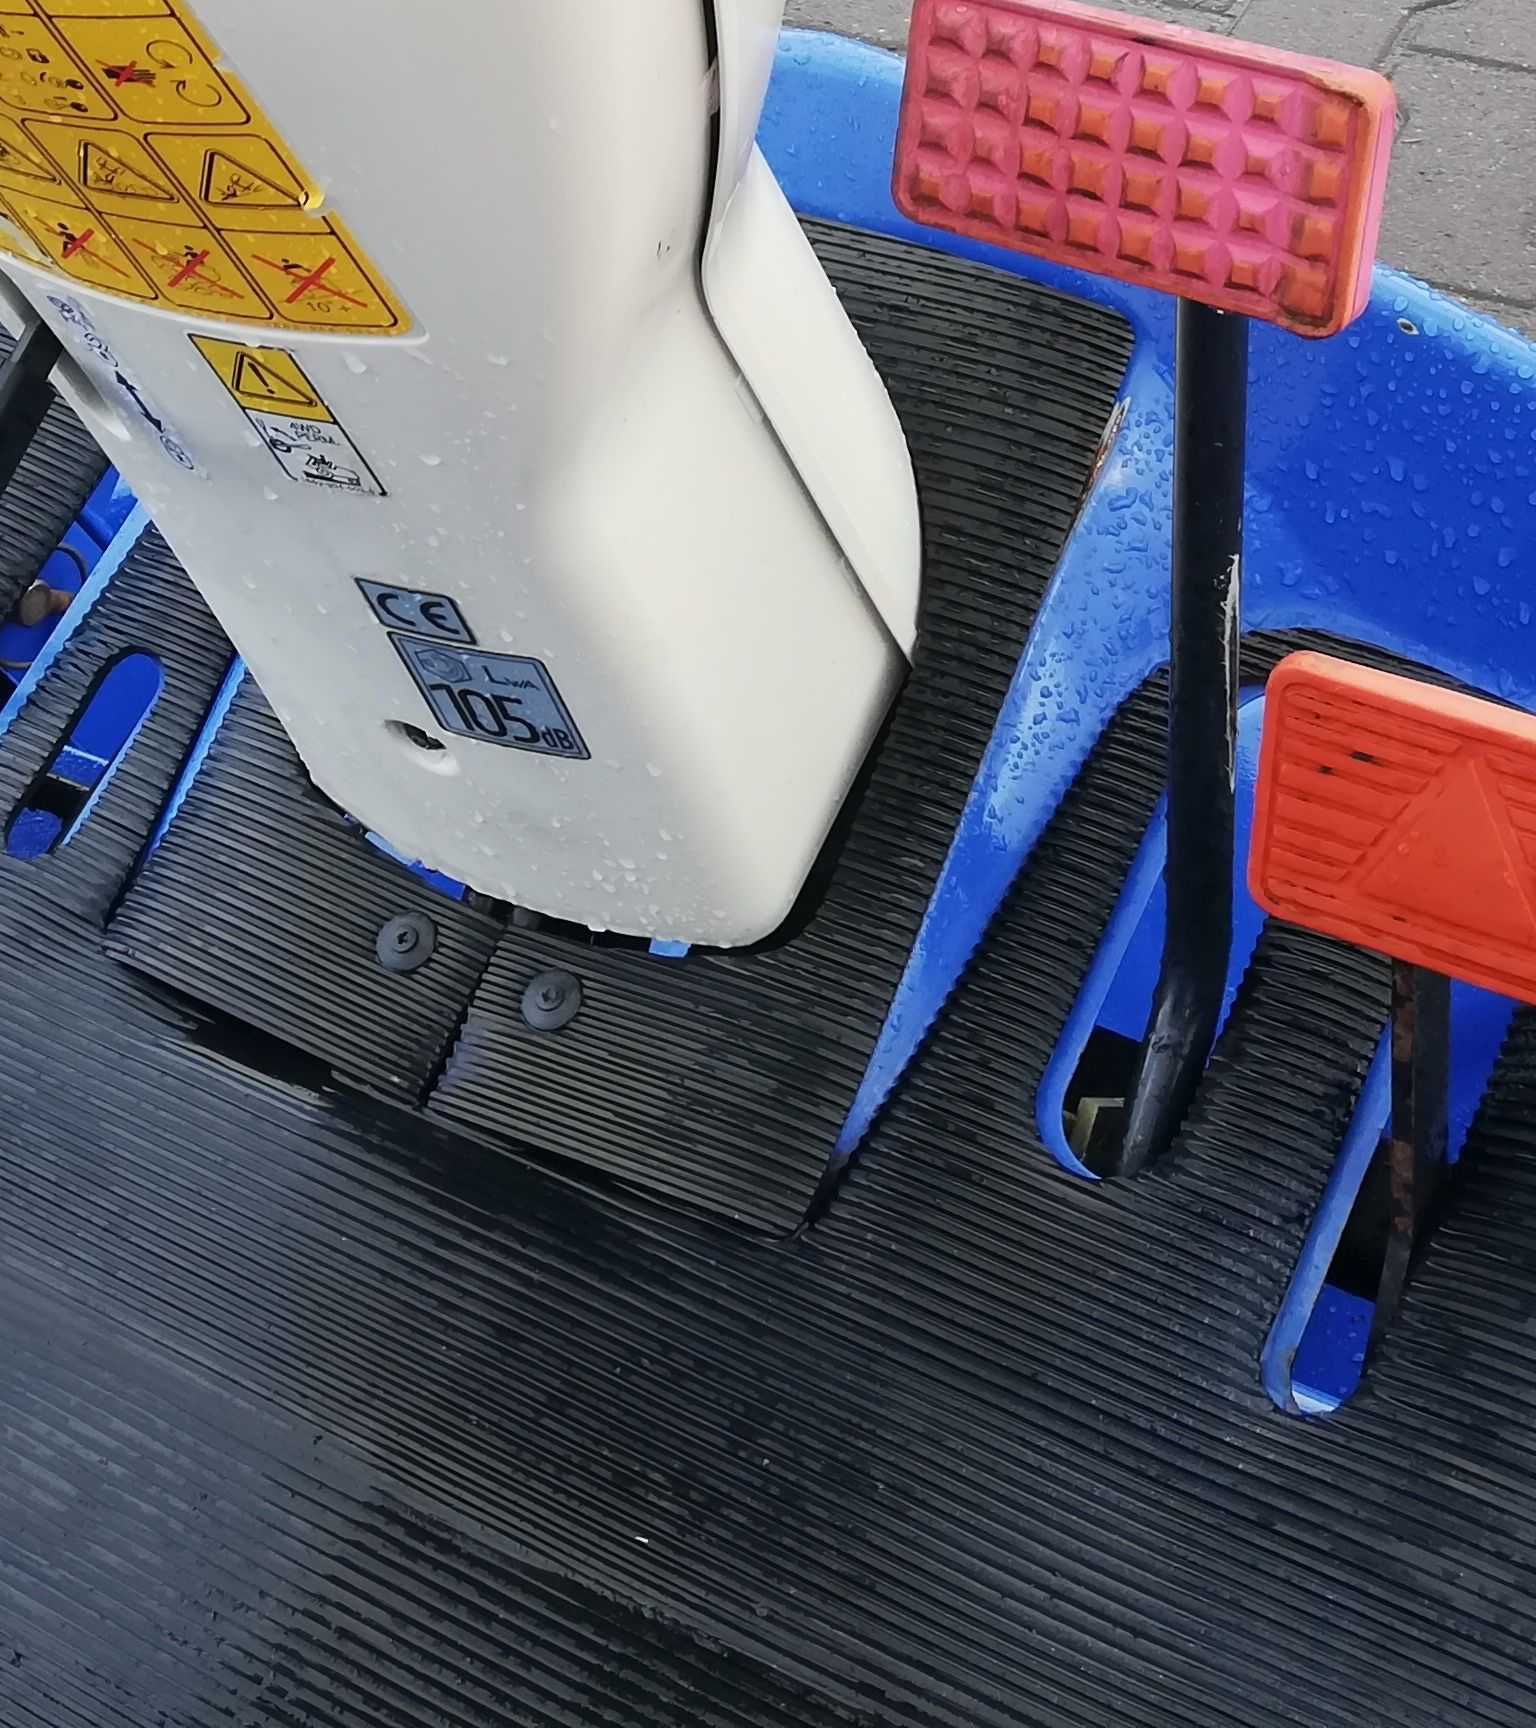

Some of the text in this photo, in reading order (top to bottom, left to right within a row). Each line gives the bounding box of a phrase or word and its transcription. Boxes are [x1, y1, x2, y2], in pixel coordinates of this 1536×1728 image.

[376, 592, 460, 635] CE
[429, 683, 574, 750] 105 dB
